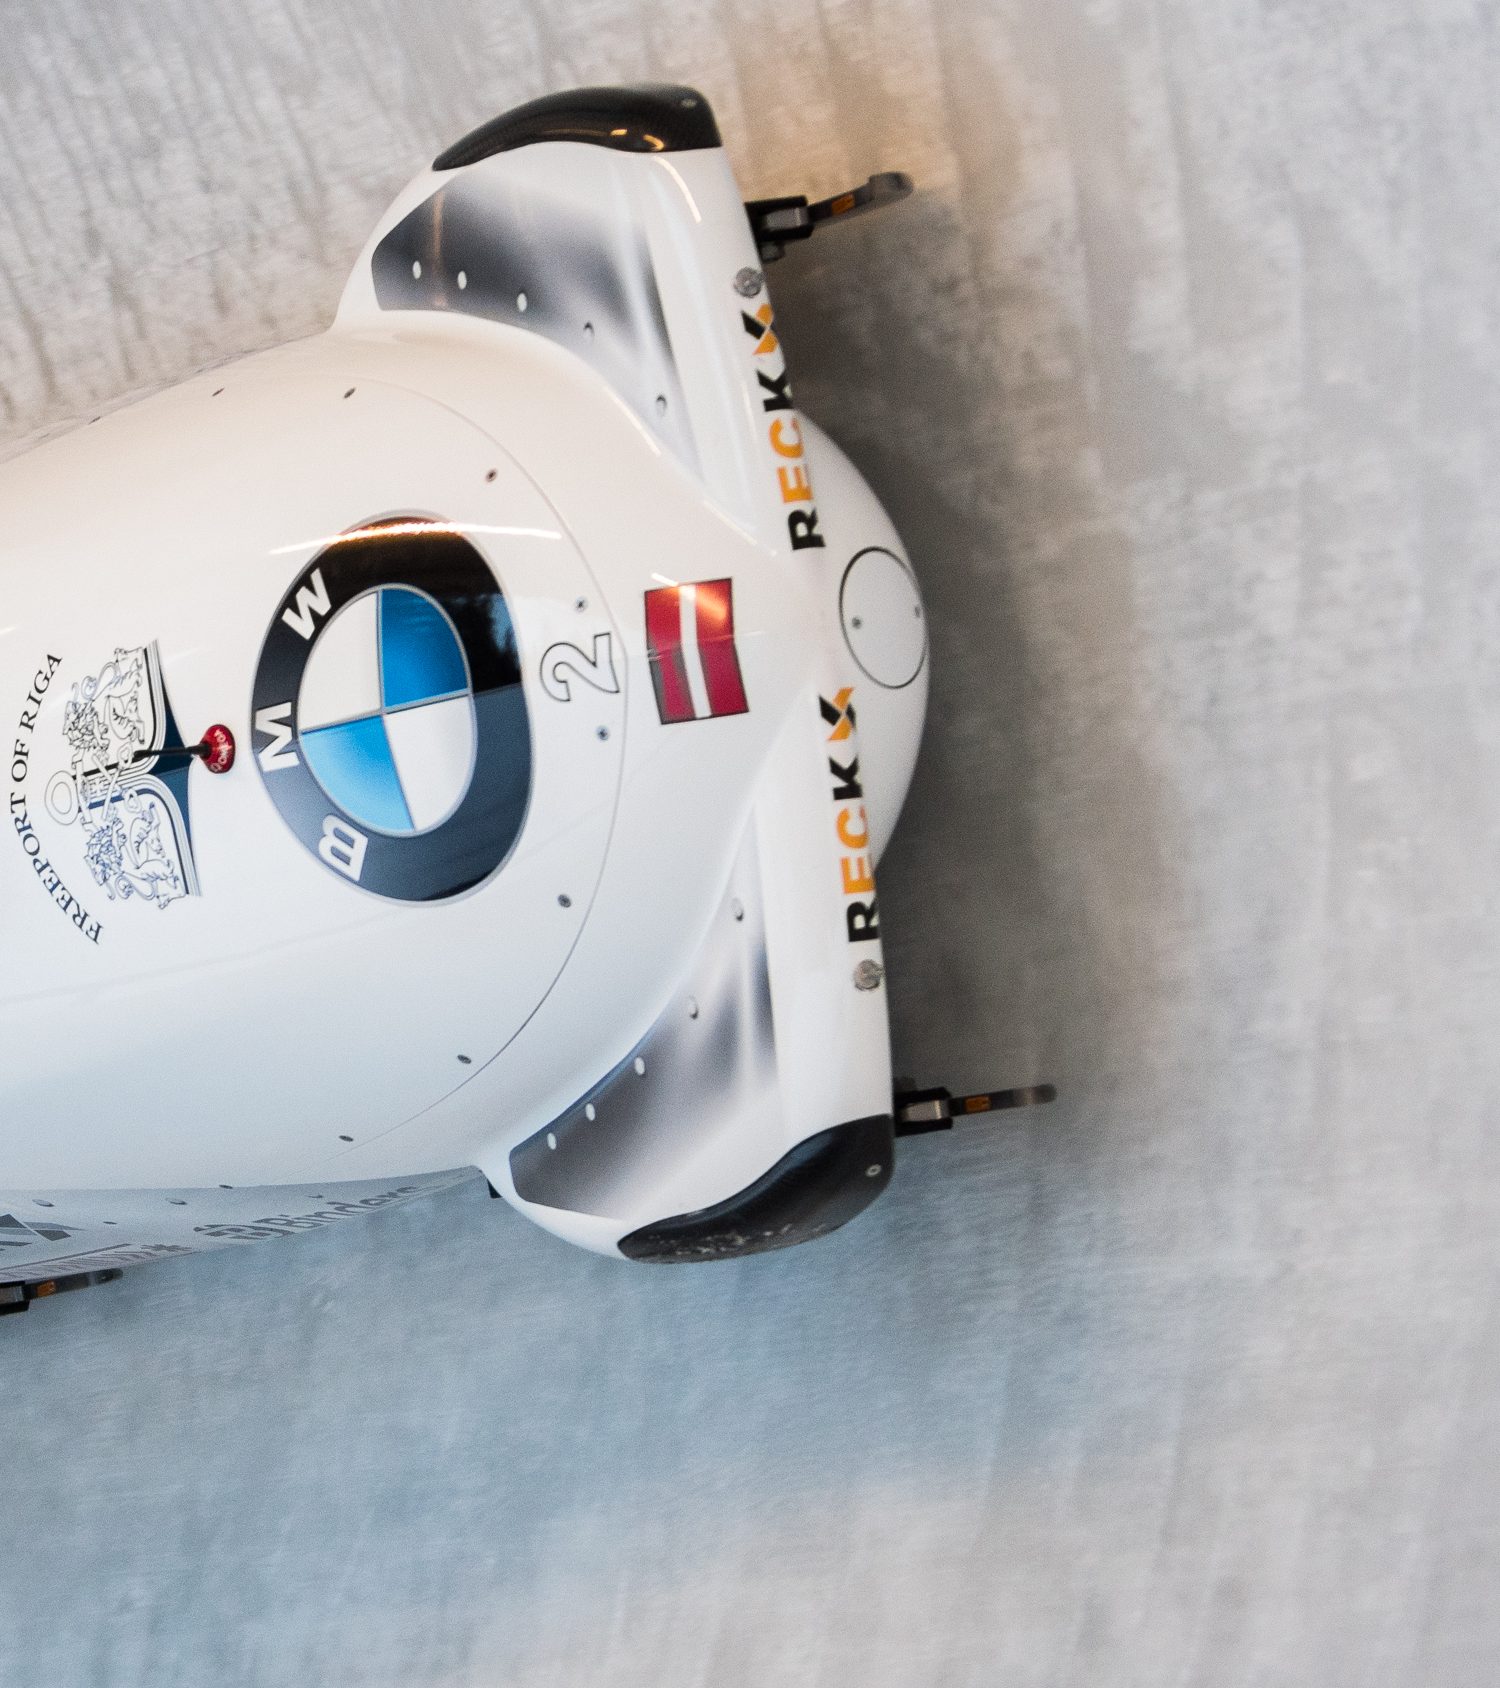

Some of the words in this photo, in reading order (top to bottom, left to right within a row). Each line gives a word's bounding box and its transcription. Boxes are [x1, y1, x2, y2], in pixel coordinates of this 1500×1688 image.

[19, 653, 63, 739] RIGA
[539, 632, 620, 702] 2
[10, 739, 31, 783] OF
[255, 567, 368, 881] BMW
[11, 793, 104, 945] FREEPORT
